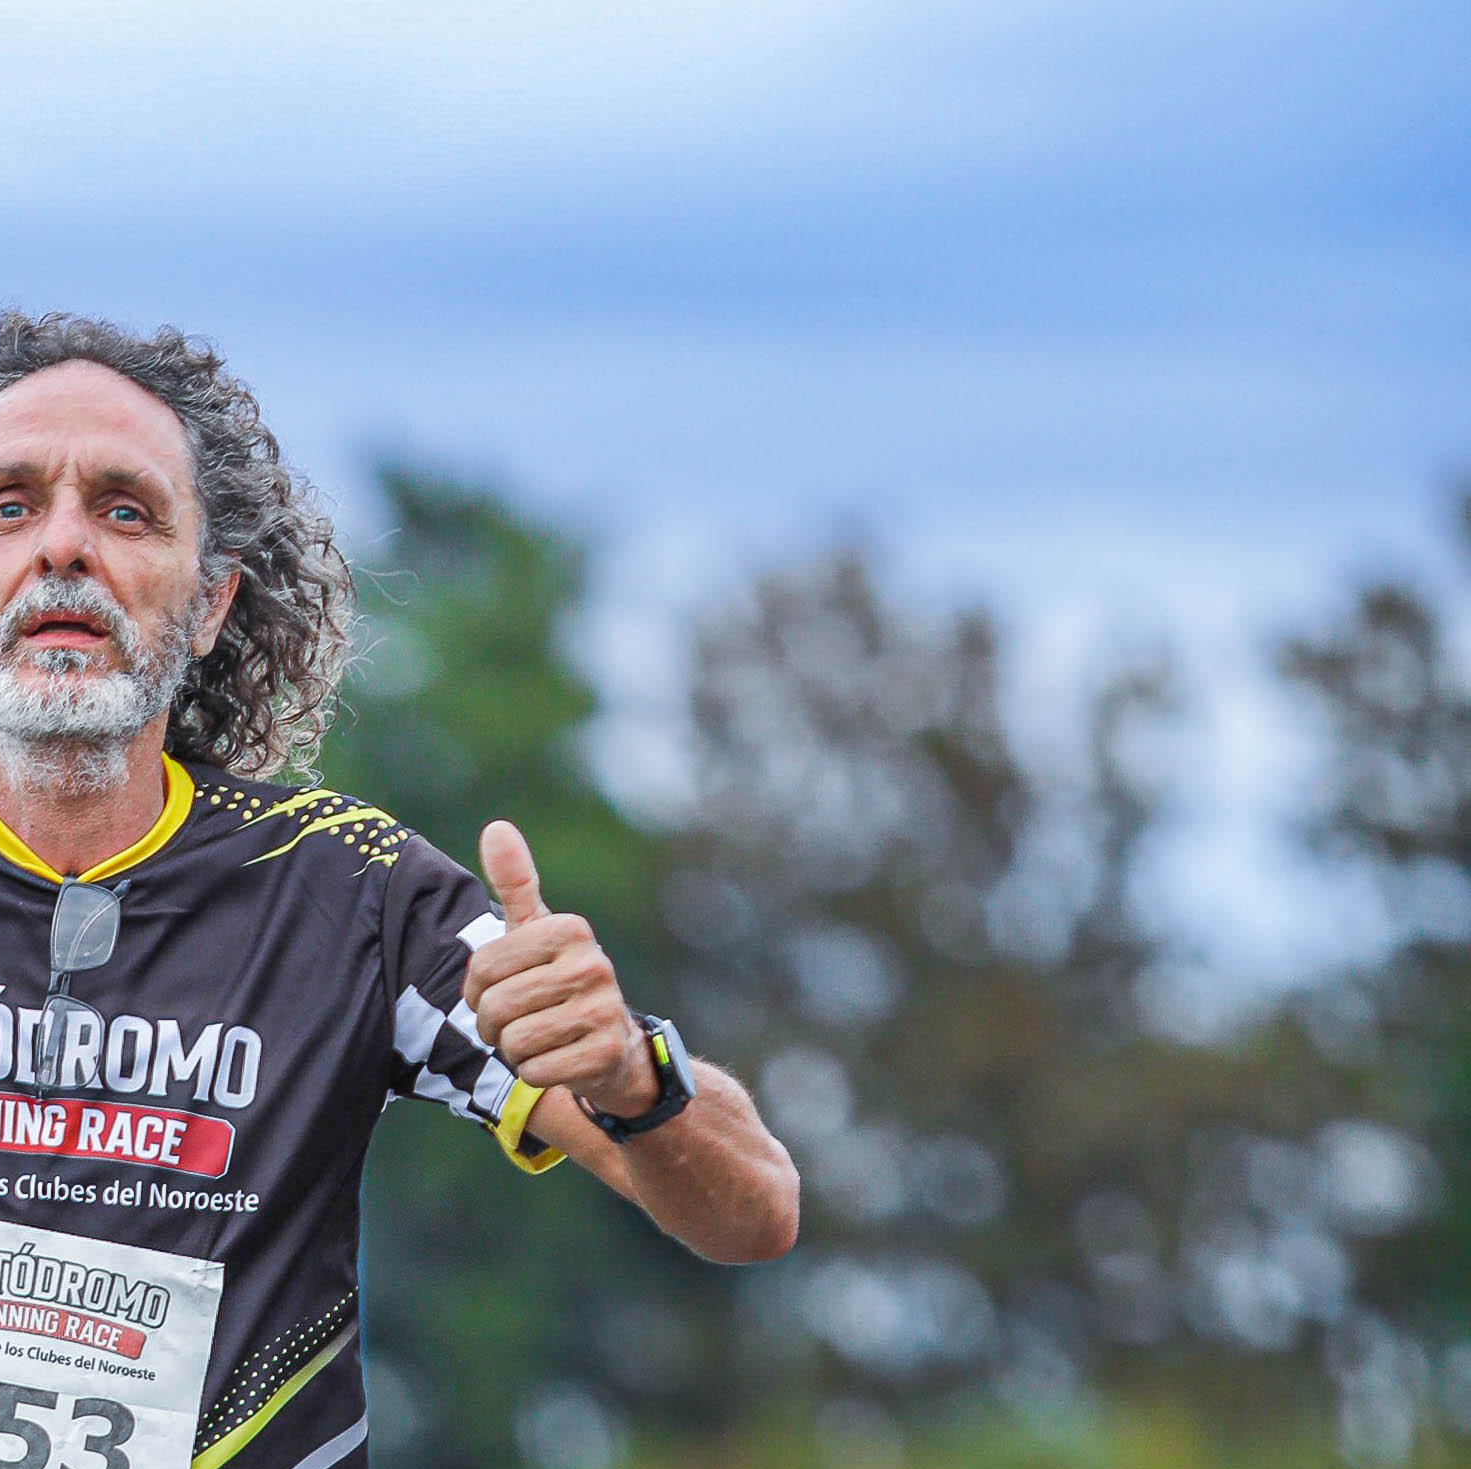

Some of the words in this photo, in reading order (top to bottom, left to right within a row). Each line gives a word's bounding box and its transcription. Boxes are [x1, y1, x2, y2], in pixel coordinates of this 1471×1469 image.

[76, 1107, 188, 1165] RACE
[14, 1173, 97, 1205] Clubes
[102, 1179, 142, 1208] del
[148, 1182, 260, 1213] Noroeste
[63, 1315, 125, 1351] RACE
[5, 1341, 24, 1358] los
[27, 1346, 71, 1367] Clubes
[76, 1355, 96, 1371] del
[98, 1360, 156, 1382] Noroeste
